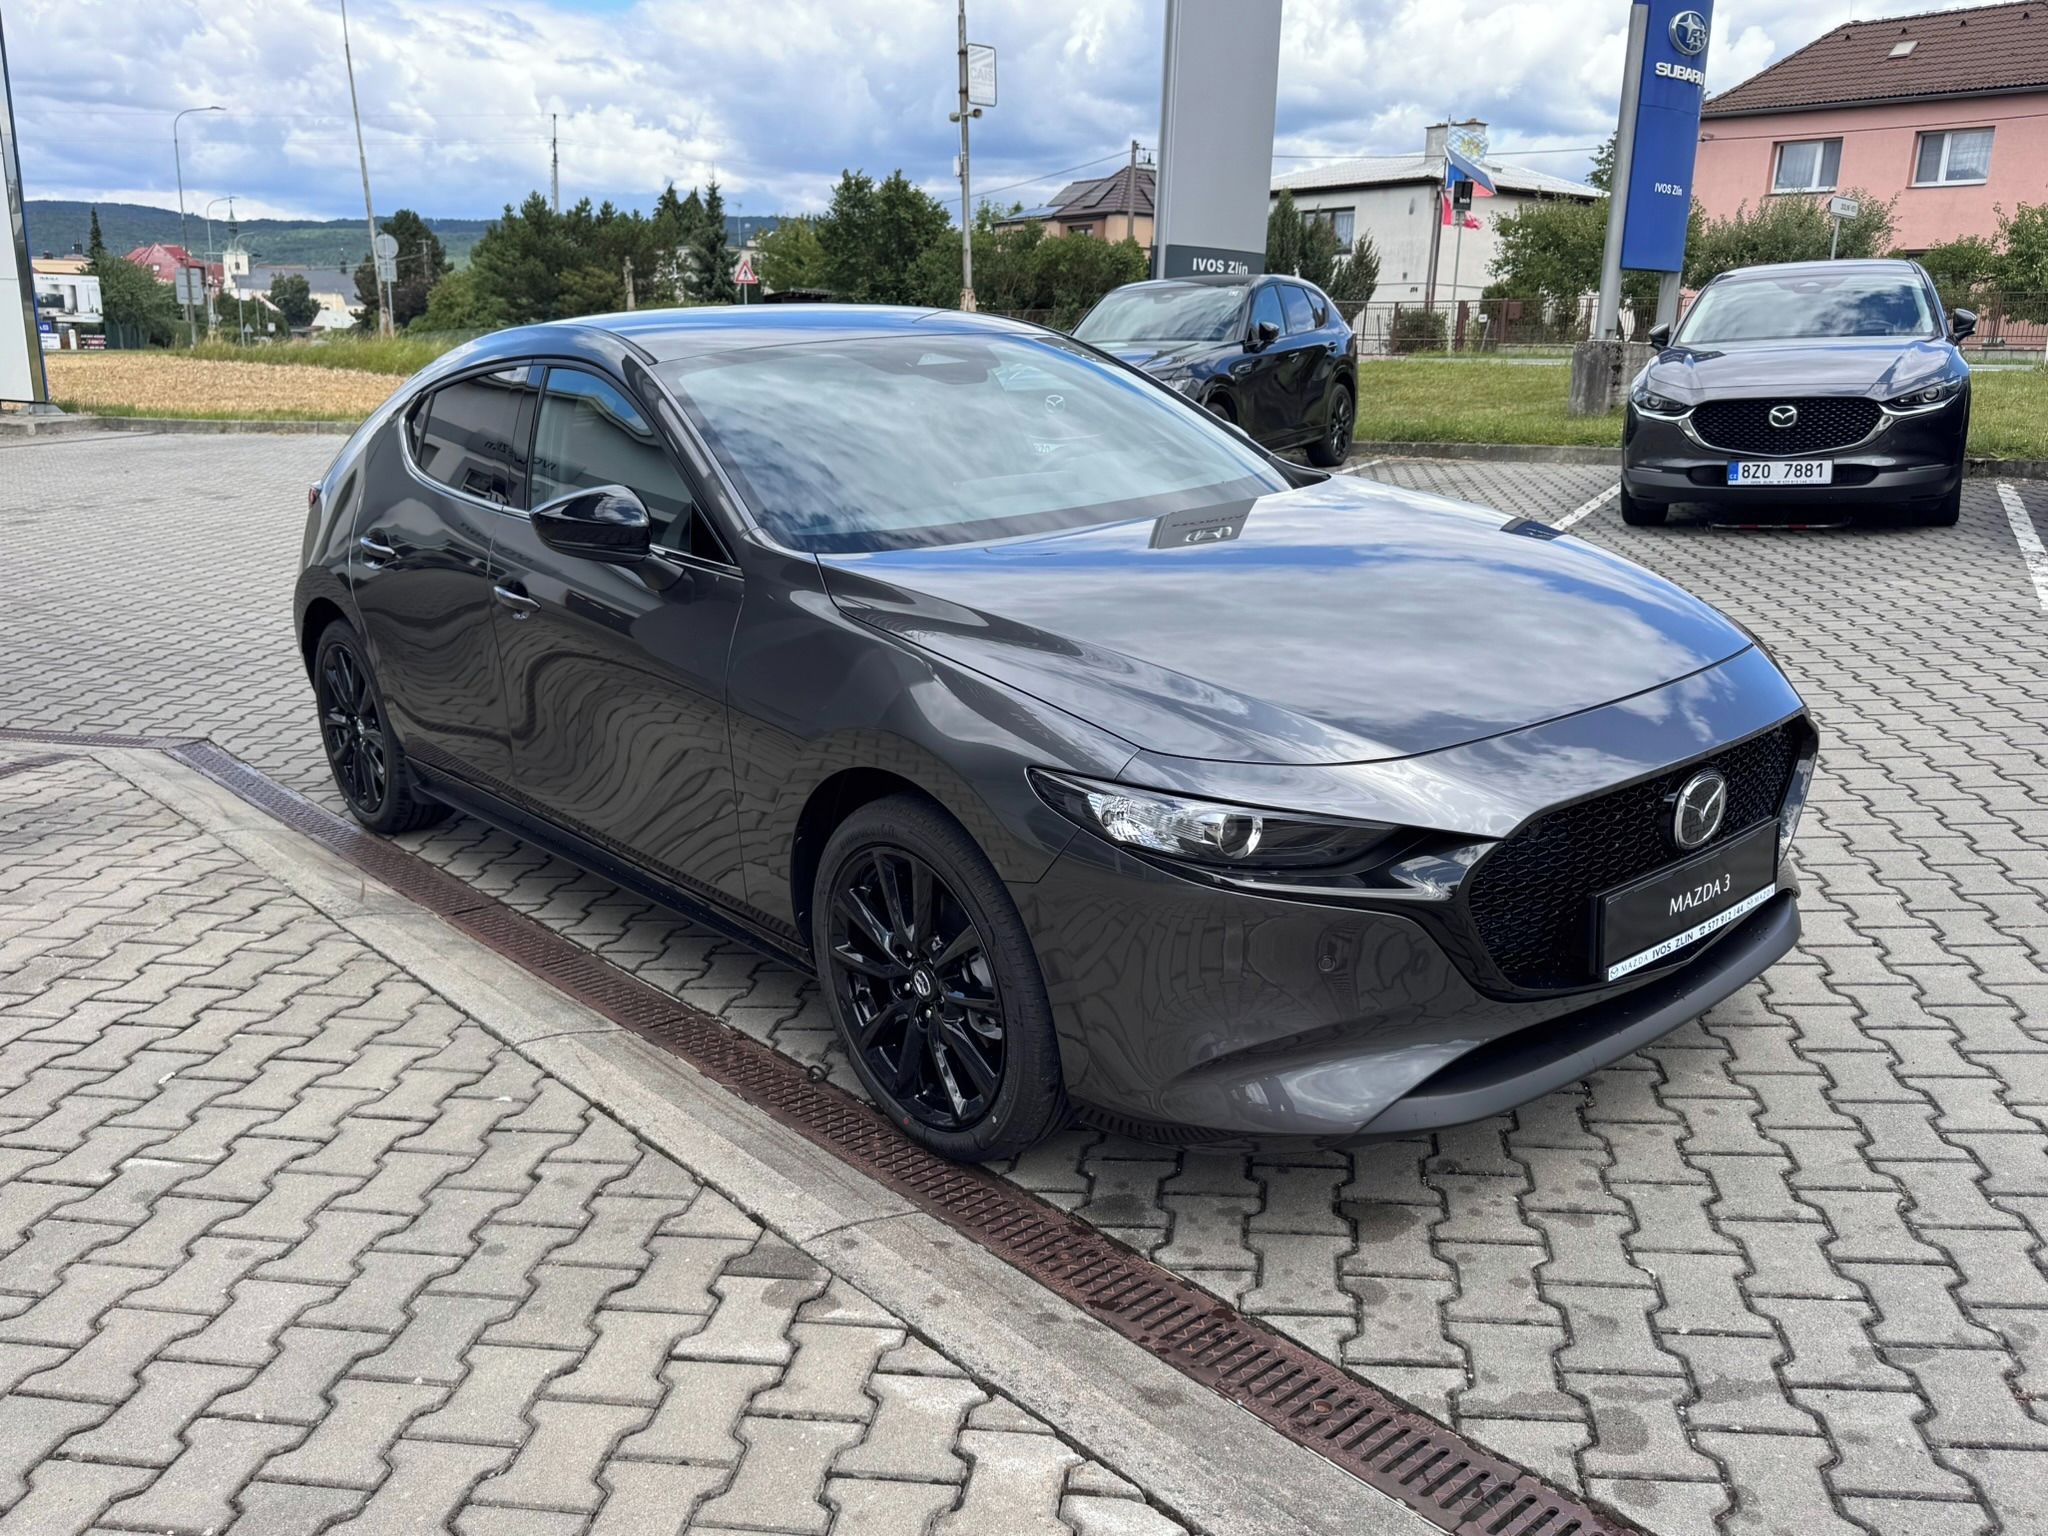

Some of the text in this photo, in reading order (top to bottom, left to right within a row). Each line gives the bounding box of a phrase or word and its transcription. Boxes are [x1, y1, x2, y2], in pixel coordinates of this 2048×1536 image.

[1655, 62, 1705, 86] SUBARU
[1654, 182, 1672, 195] IVOS
[1192, 257, 1249, 276] IVOS Zlín
[1741, 462, 1824, 479] 8Z0 7881
[1669, 873, 1731, 917] MAZDA 3
[1620, 954, 1649, 972] MAZDA
[1652, 942, 1672, 959] IVOS
[1675, 931, 1694, 948] ZLIN
